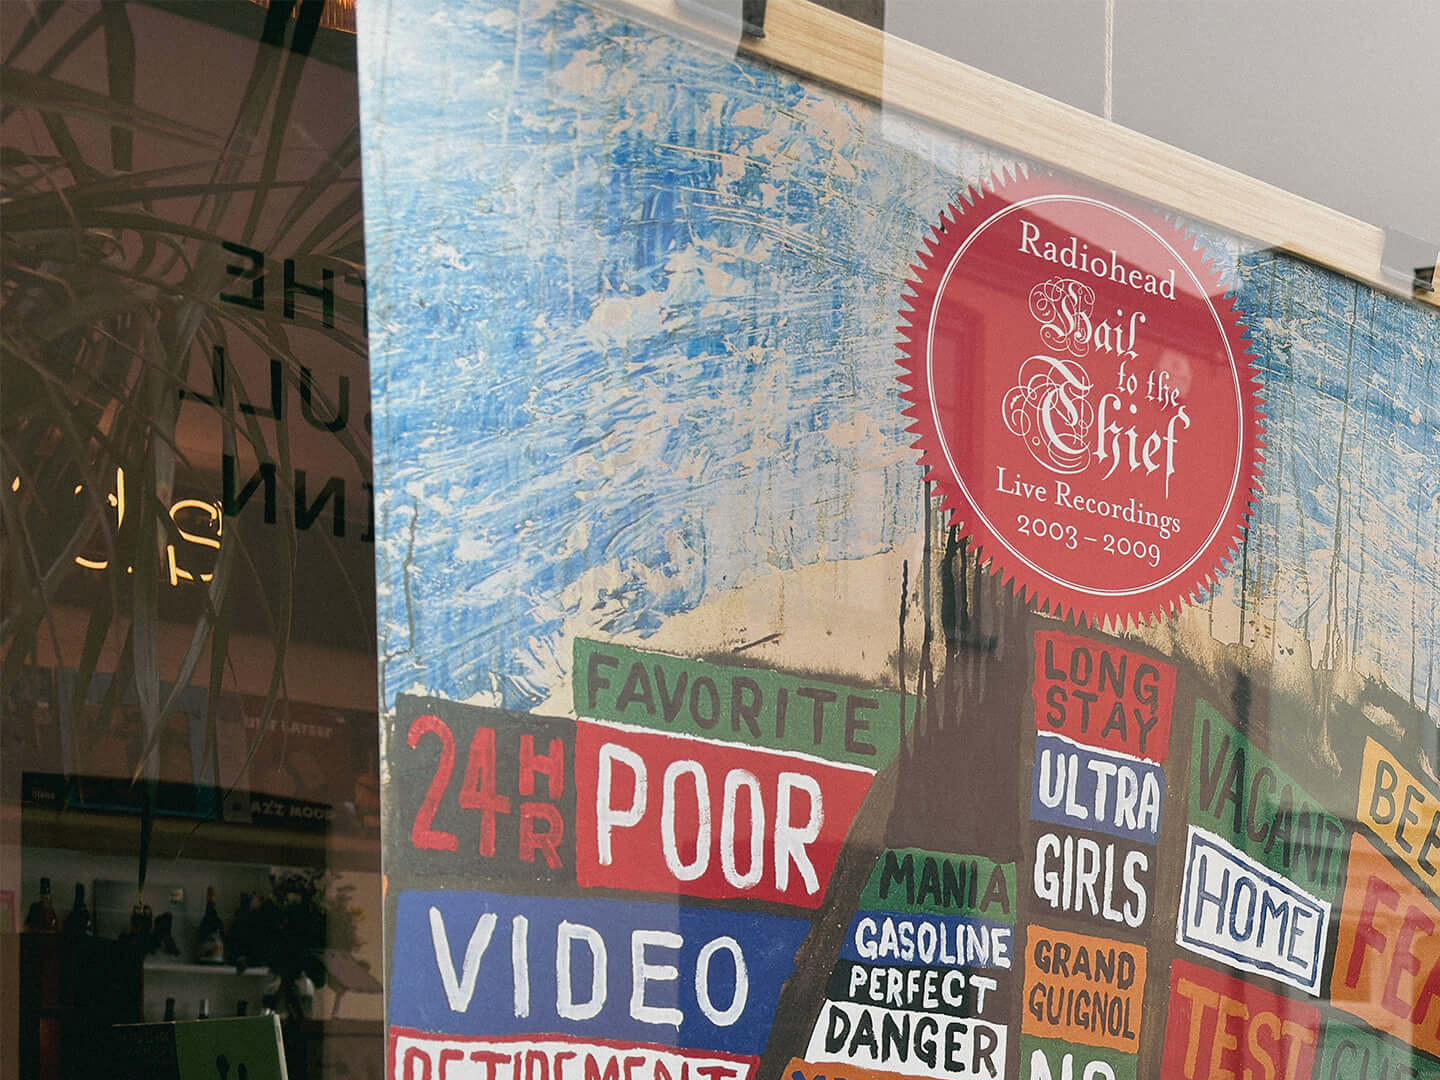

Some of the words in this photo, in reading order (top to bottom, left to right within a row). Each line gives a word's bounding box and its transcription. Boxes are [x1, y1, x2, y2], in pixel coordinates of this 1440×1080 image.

[1018, 220, 1176, 300] Radiohead
[1029, 276, 1146, 358] Hail
[1118, 360, 1138, 396] to
[1147, 369, 1181, 408] the
[1001, 354, 1190, 499] Thief
[996, 466, 1047, 502] Live
[1055, 482, 1181, 538] Recordings
[1017, 515, 1077, 549] 2003
[1103, 534, 1160, 567] 2009
[587, 651, 880, 756] FAVORITE
[1044, 640, 1160, 706] LONG
[1046, 685, 1158, 753] STAY
[407, 714, 510, 858] 24
[596, 742, 825, 896] POOR
[1039, 749, 1161, 834] ULTRA
[1199, 719, 1344, 891] VACANT
[879, 852, 1010, 914] MANIA
[1033, 833, 1149, 928] GIRLS
[1194, 854, 1313, 969] HOME
[429, 906, 749, 1029] VIDEO
[854, 907, 1012, 969] GASOLINE
[1034, 939, 1136, 991] GRAND
[848, 965, 997, 1015] PERFECT
[1028, 981, 1136, 1041] GUIGNOL
[824, 1005, 999, 1079] DANGER
